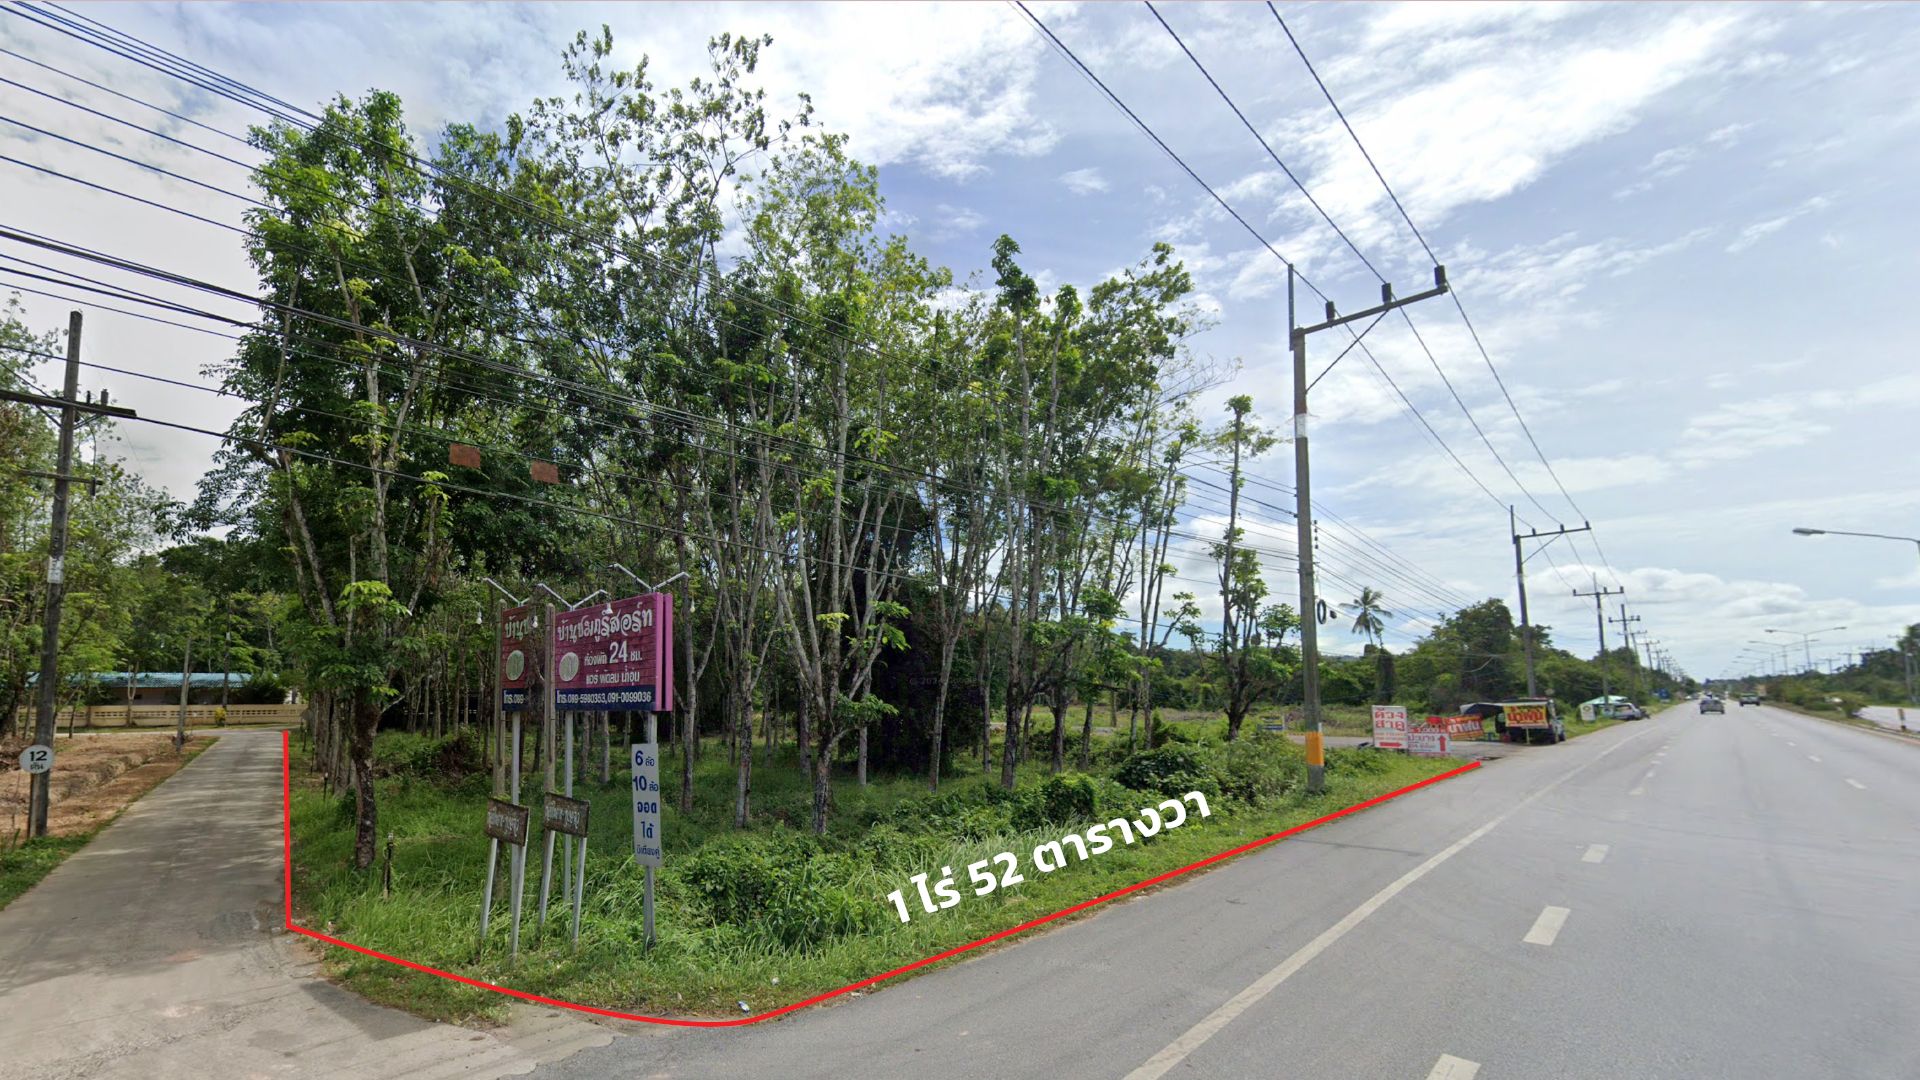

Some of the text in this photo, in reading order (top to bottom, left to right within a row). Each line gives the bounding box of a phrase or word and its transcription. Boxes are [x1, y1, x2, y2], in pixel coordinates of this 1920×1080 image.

[609, 641, 629, 664] 24
[630, 650, 643, 662] ชม.
[586, 669, 599, 685] แอร์
[621, 665, 640, 686] น้ำอุ่น
[30, 750, 47, 761] 12
[635, 750, 655, 767] 6 ล้อ
[633, 775, 659, 792] 10 ล้อ
[637, 802, 657, 814] จอด
[641, 821, 654, 839] ได้
